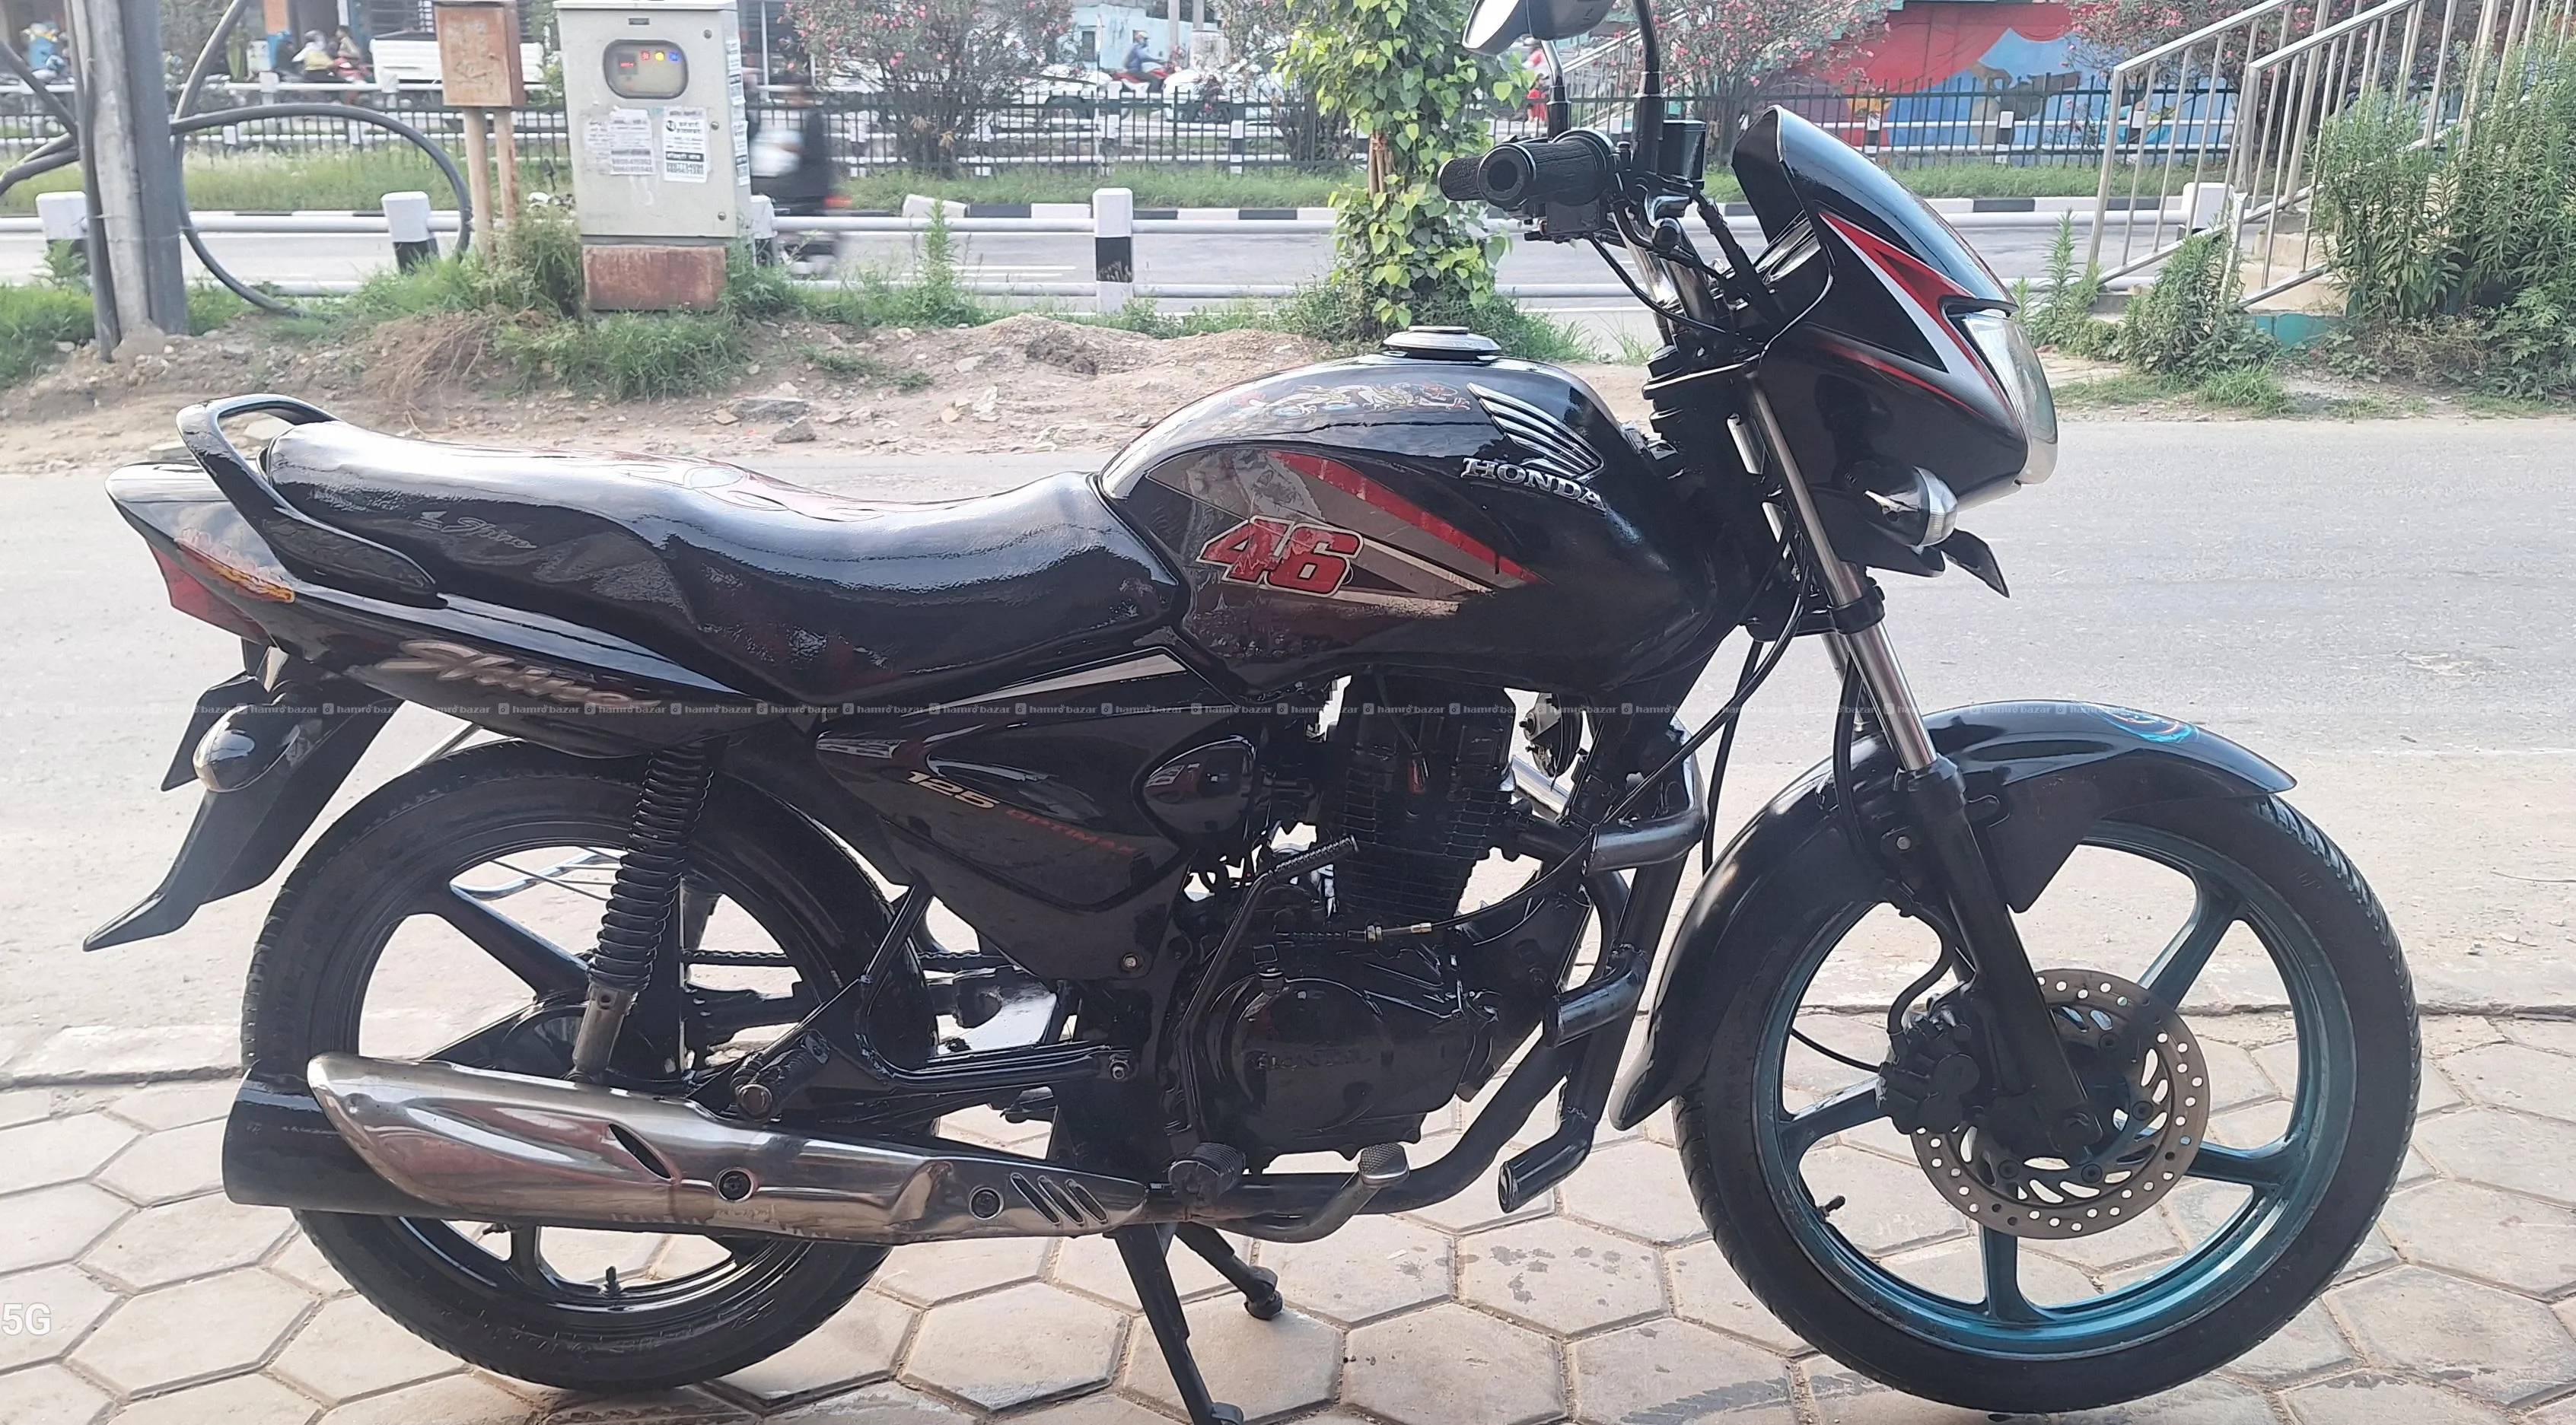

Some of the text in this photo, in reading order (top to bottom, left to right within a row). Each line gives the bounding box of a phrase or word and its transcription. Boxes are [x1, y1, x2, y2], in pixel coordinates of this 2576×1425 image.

[1460, 457, 1607, 512] HONDA
[1196, 514, 1364, 597] 46
[906, 770, 1001, 810] 125
